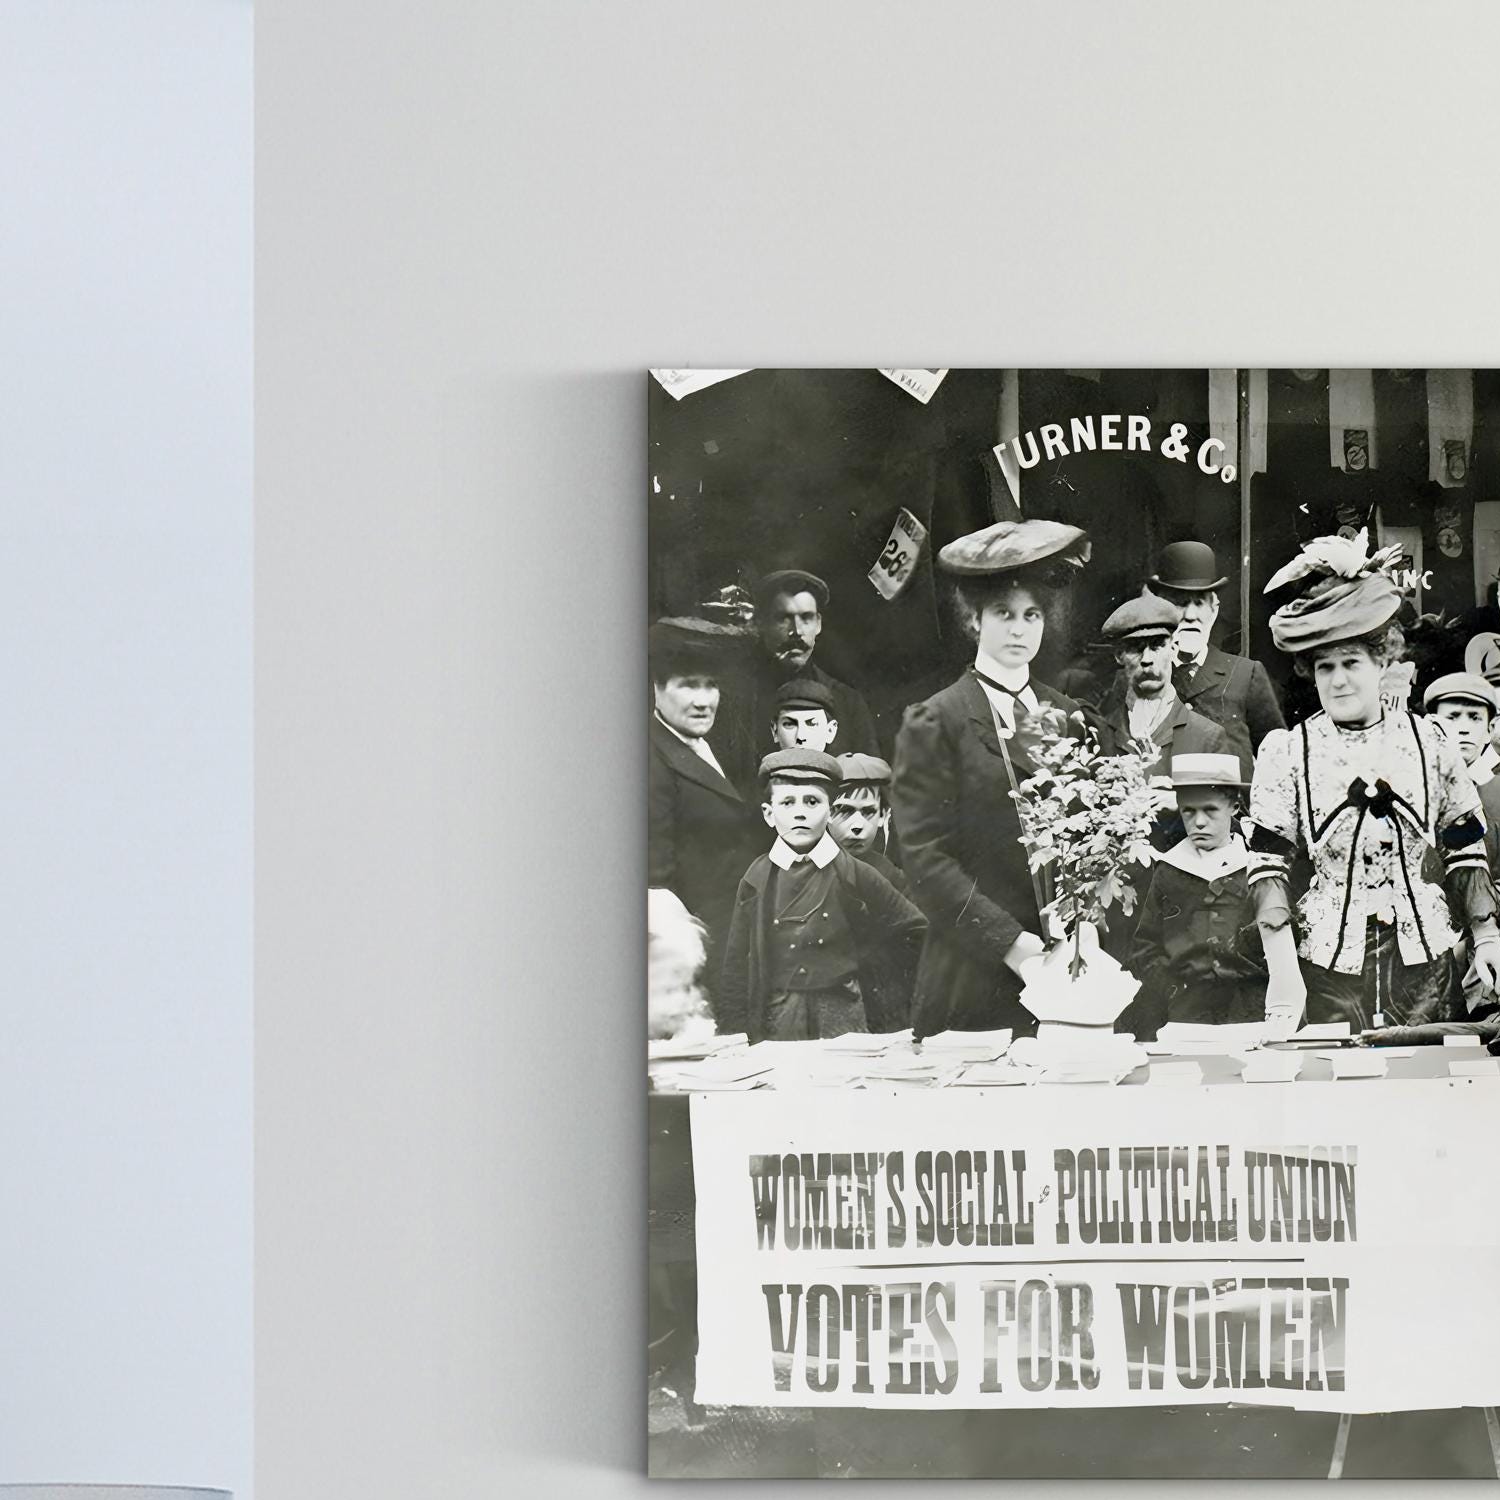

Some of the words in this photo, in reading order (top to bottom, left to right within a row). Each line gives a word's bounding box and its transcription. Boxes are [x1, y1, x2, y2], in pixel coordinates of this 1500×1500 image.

[749, 1150, 907, 1251] WOMEN'S
[915, 1149, 1035, 1248] SOCIAL
[1053, 1145, 1238, 1244] POLITICAL
[1244, 1145, 1358, 1243] UNION
[761, 1281, 959, 1395] VOTES
[979, 1279, 1101, 1393] FOR
[1115, 1277, 1350, 1392] WOMEN
